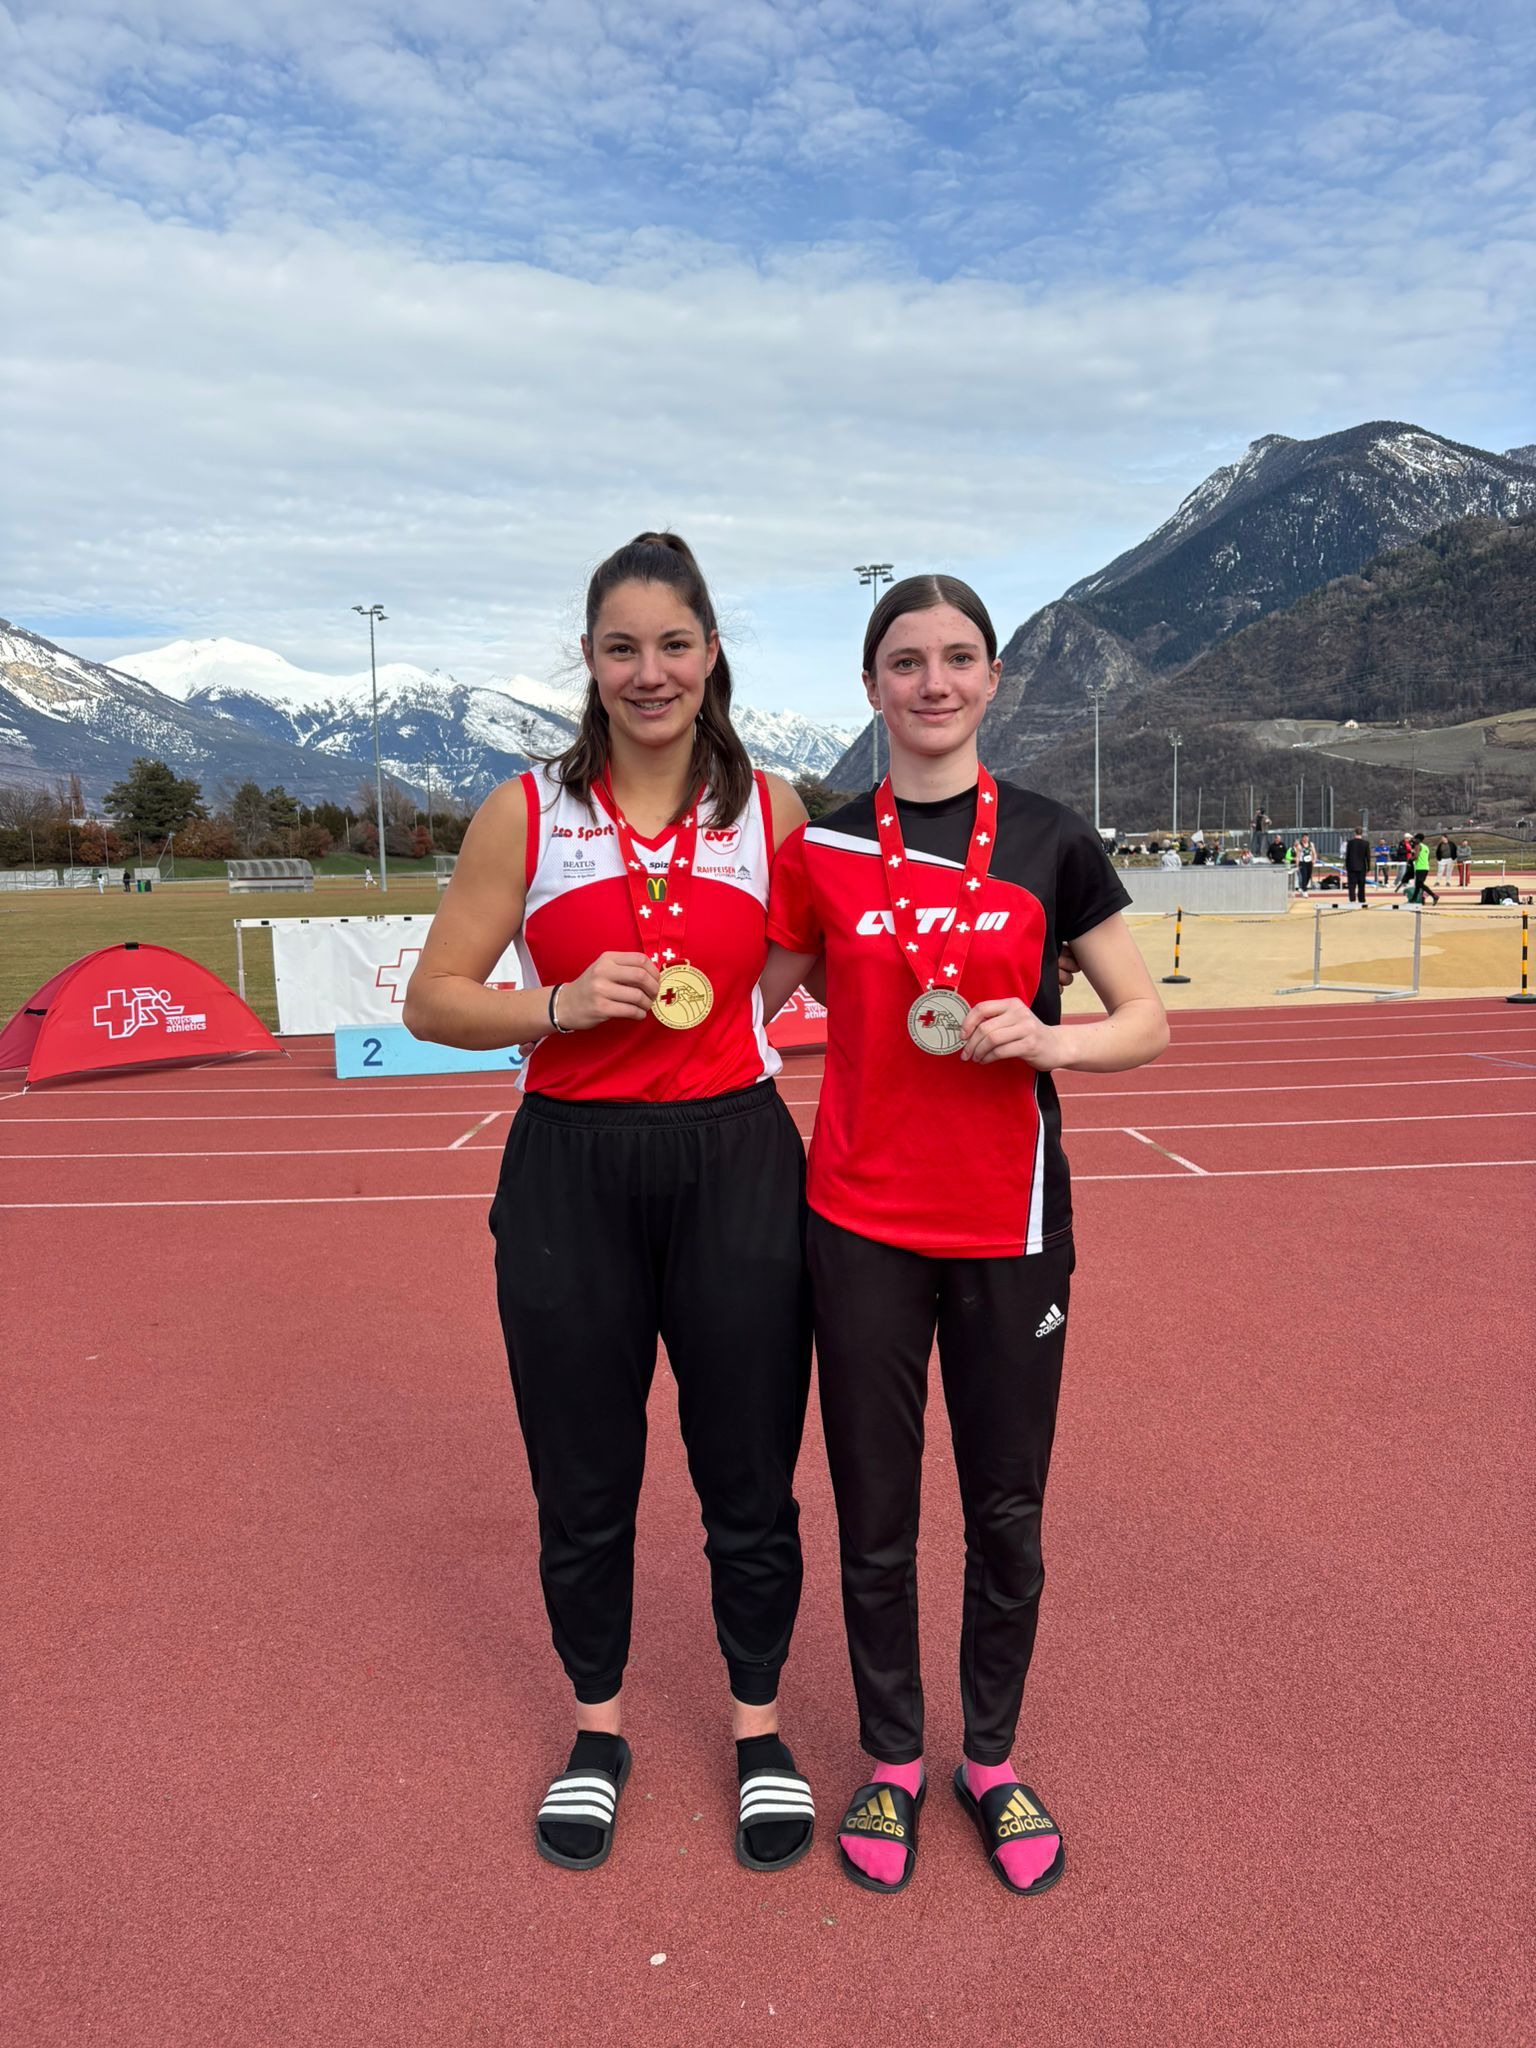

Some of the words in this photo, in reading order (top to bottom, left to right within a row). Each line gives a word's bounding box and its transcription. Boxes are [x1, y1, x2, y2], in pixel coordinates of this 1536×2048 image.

[578, 824, 615, 841] Sport
[563, 860, 596, 868] BEATUS
[166, 1021, 207, 1032] athletics
[363, 1038, 383, 1067] 2
[1035, 1314, 1065, 1338] adidas
[846, 1814, 905, 1837] adidas
[998, 1815, 1054, 1838] adidas
